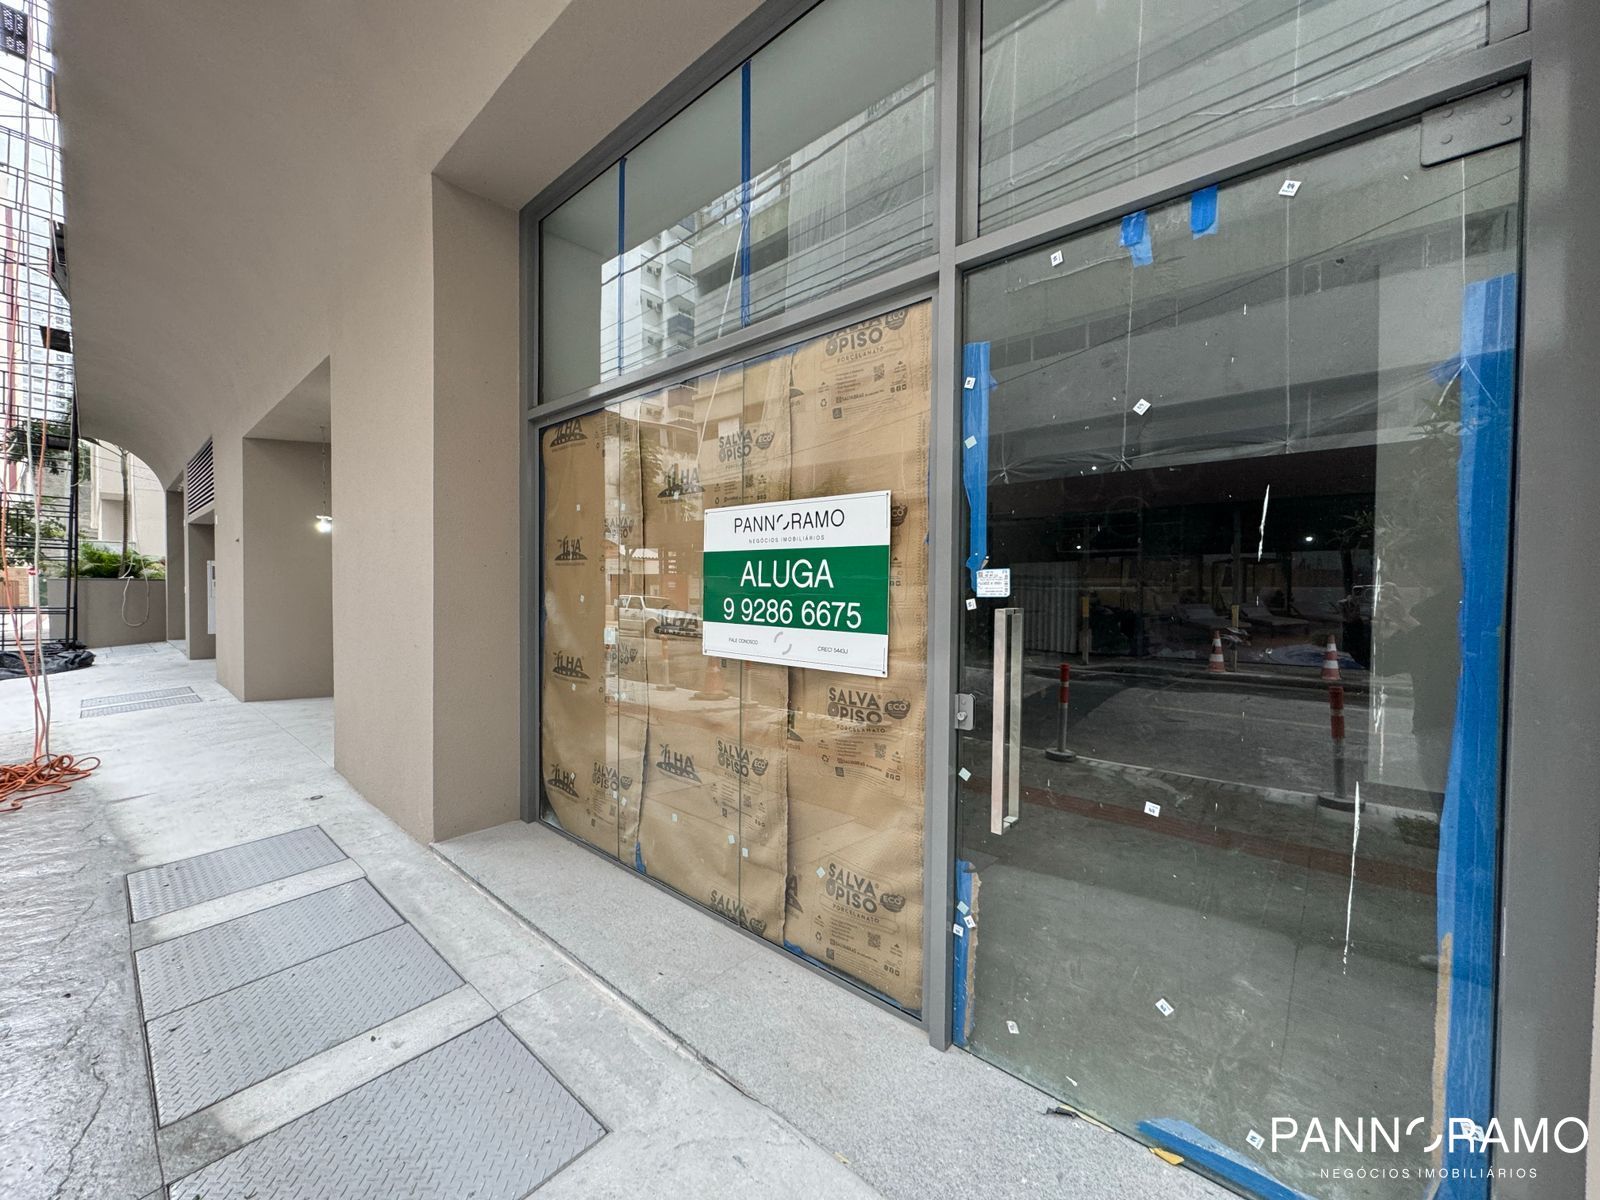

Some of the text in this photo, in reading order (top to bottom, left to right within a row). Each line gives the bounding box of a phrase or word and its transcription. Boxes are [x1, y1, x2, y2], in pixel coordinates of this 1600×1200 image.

[719, 429, 753, 449] SALVA
[740, 558, 834, 589] ALUGA
[723, 597, 862, 629] 9 9286 6675
[828, 687, 907, 711] SALVA ECO
[718, 740, 750, 763] SALVA
[828, 863, 877, 898] SALVA
